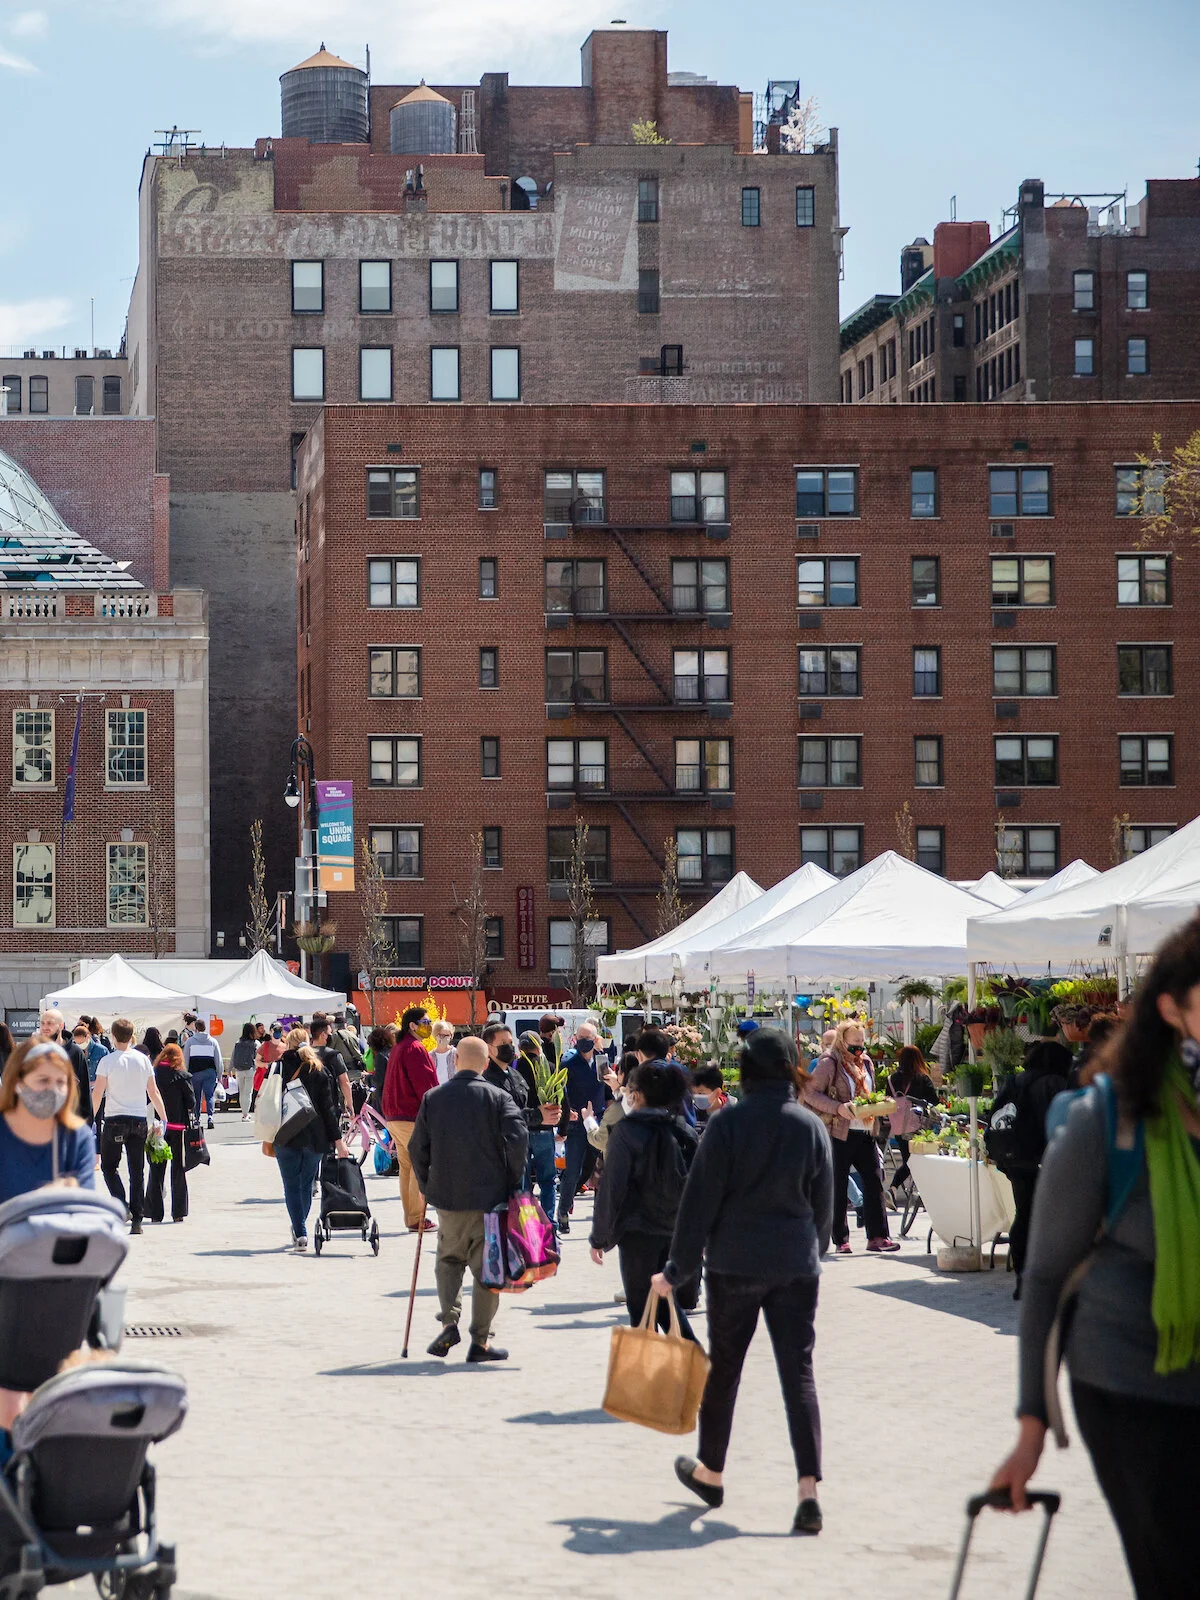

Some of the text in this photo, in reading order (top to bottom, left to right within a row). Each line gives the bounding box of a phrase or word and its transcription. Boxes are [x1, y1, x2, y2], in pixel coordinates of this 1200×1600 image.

[576, 199, 623, 216] CIVILIAN
[585, 216, 609, 228] AND
[569, 226, 620, 245] MILITARY
[329, 825, 352, 835] UNION
[322, 833, 351, 845] SQUARE
[519, 890, 528, 967] OPTIQUE
[375, 976, 479, 988] DUNKIN' DONUTS
[512, 994, 548, 1003] PETITE
